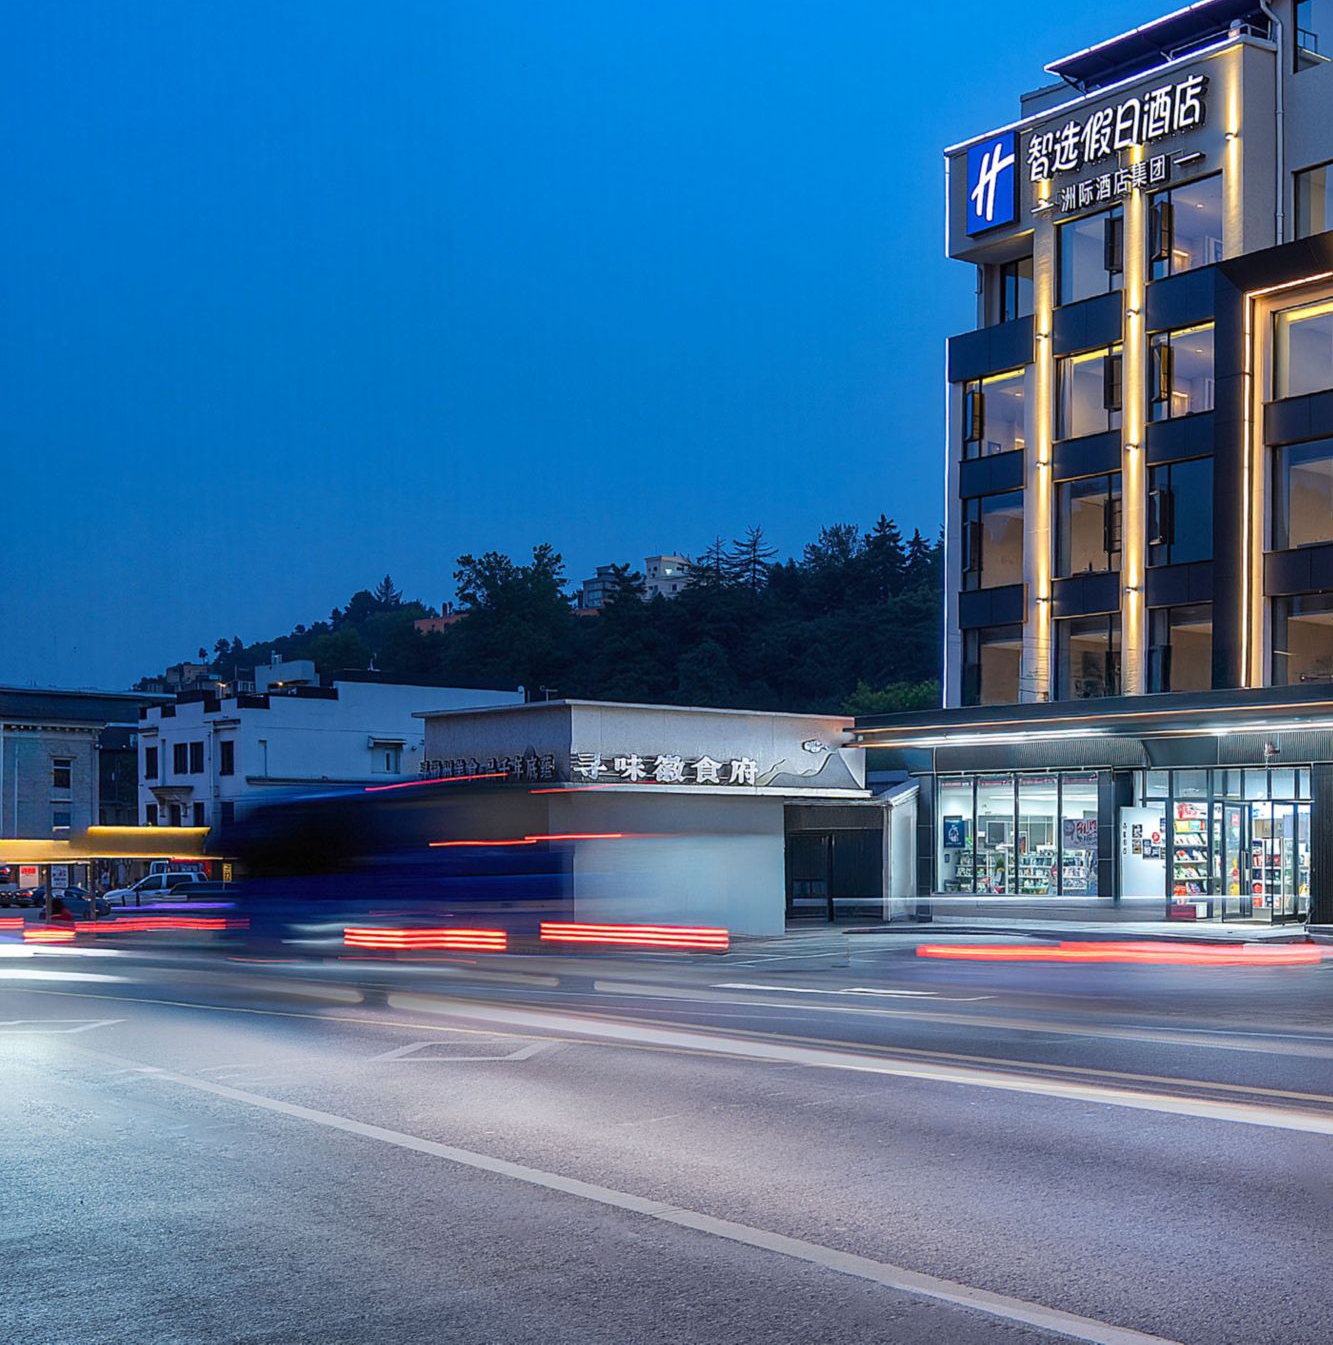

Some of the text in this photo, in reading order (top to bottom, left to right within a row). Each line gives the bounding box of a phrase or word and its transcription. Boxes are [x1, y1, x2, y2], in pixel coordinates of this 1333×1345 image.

[1027, 75, 1205, 182] 智选假日酒店
[1060, 154, 1166, 213] 洲际酒店集团
